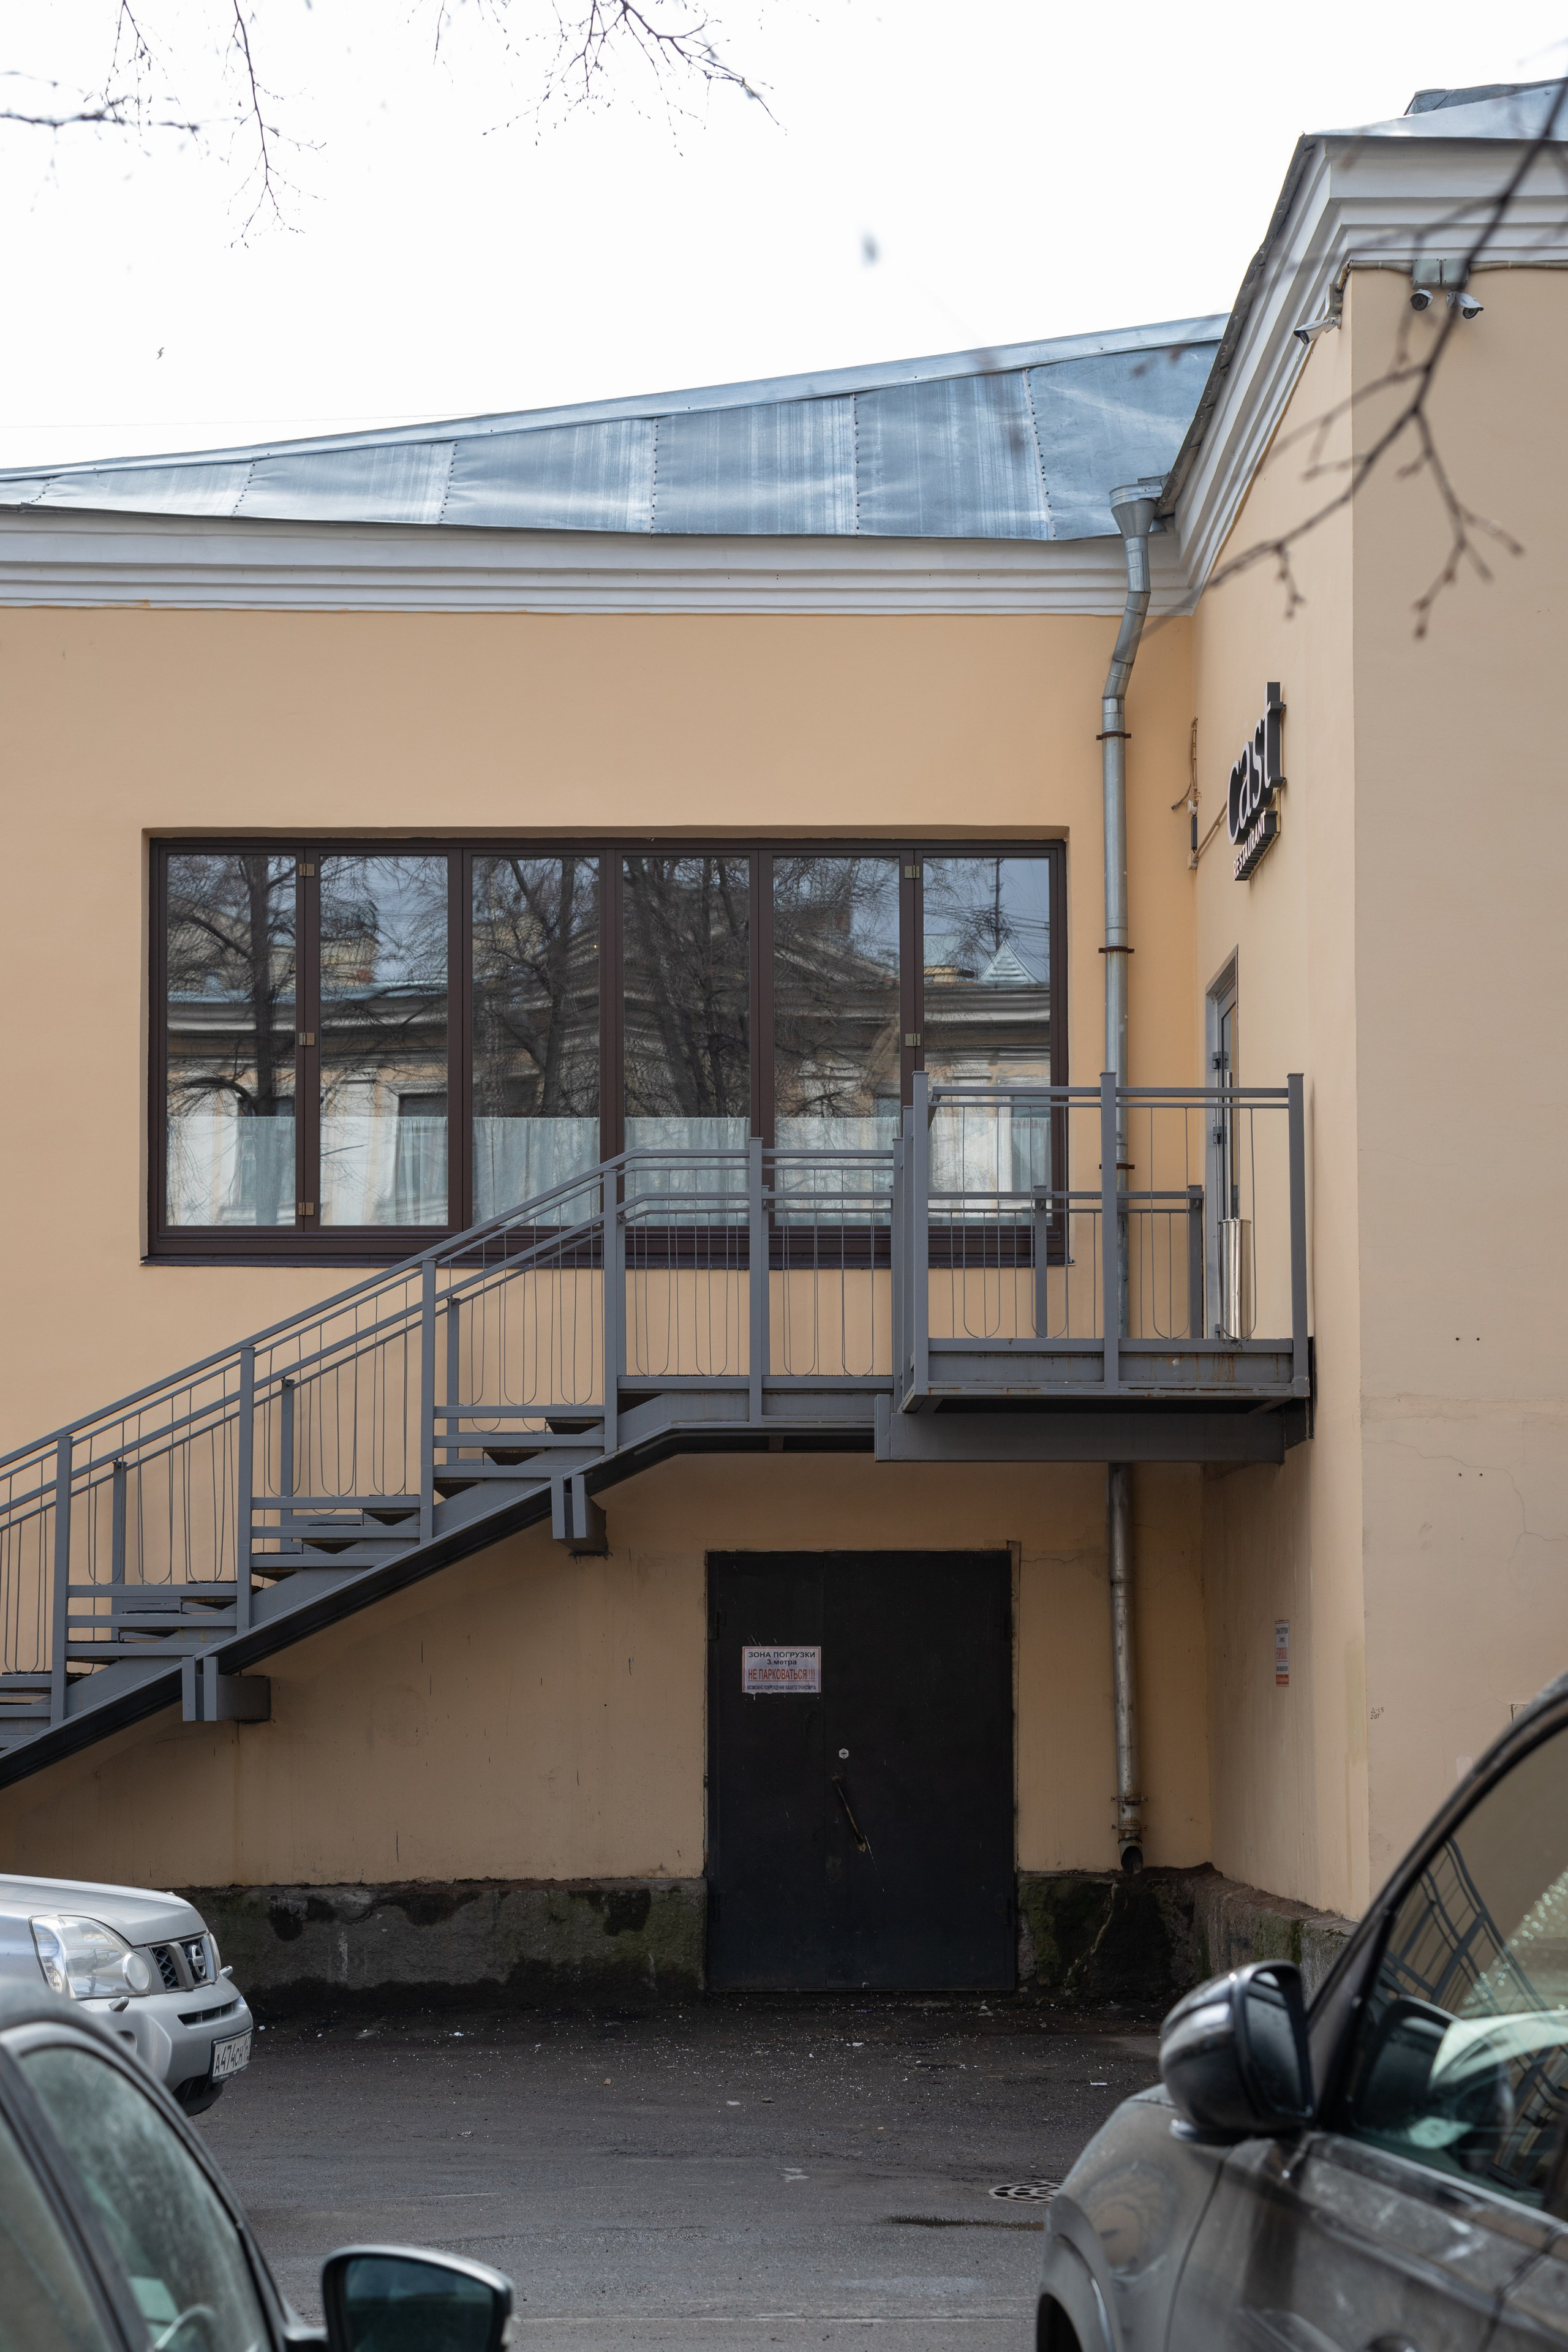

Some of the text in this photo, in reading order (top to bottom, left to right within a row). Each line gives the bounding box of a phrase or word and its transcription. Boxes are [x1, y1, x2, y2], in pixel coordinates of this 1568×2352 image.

[1227, 682, 1281, 845] cast
[1233, 810, 1267, 880] RESTAURANT
[748, 1669, 757, 1680] НЕ
[759, 1669, 807, 1680] ПАРКОВАТЬСЯ
